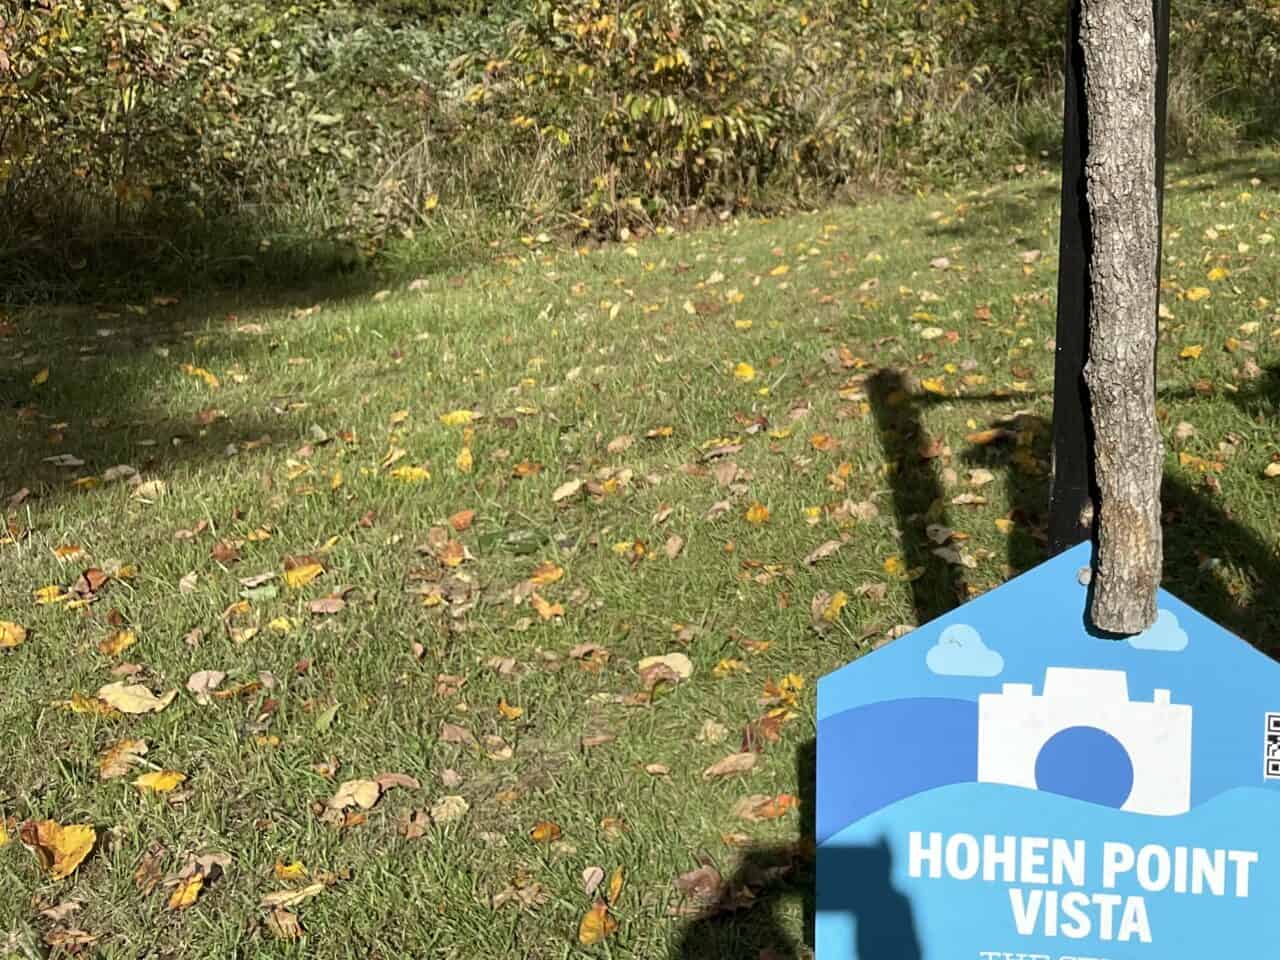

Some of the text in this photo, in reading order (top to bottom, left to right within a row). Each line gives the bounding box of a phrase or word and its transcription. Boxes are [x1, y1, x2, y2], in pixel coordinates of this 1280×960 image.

[908, 832, 1258, 897] HOHEN POINT
[1008, 888, 1153, 943] VISTA
